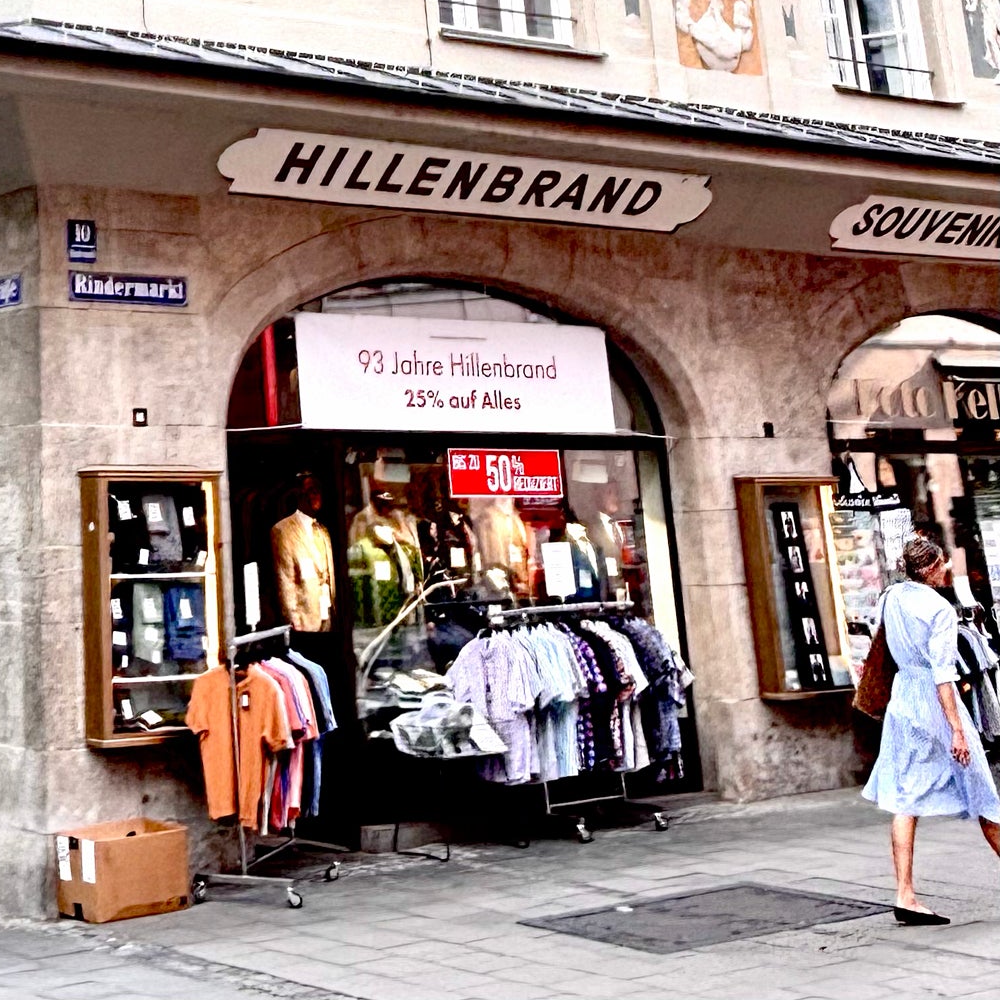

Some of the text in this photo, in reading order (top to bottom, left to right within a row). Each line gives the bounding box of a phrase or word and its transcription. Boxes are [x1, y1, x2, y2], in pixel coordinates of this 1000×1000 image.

[274, 142, 662, 217] HILLENBRAND
[75, 223, 91, 242] 10
[75, 272, 183, 299] Rindermarkt
[358, 350, 557, 380] 93 Jahre Hillenbrand
[405, 389, 521, 411] 25% auf Alles
